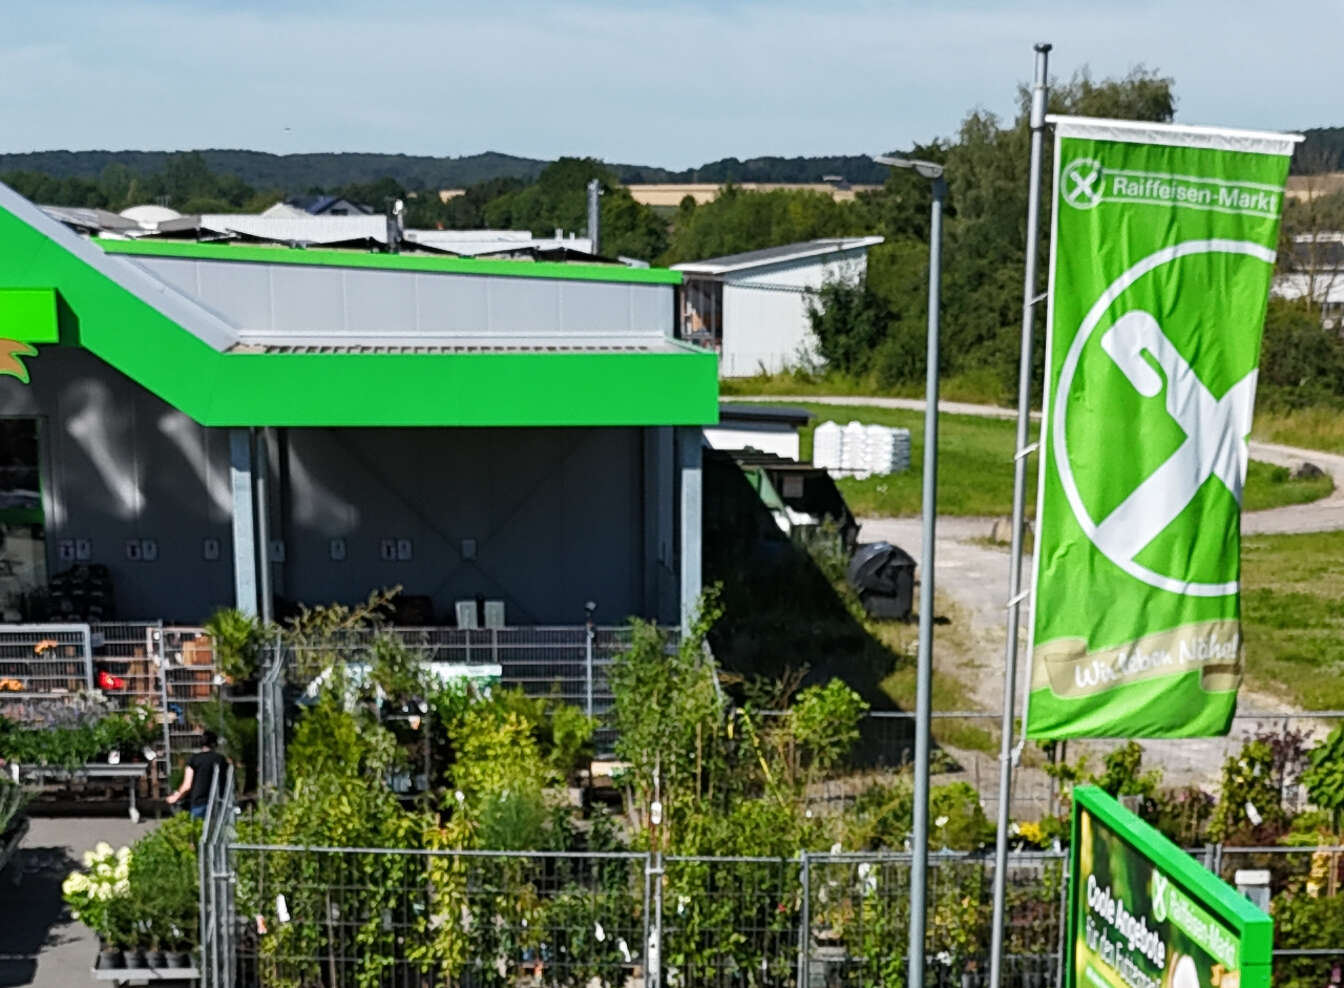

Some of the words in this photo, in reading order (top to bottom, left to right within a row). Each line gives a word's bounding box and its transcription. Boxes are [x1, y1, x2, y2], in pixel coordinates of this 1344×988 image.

[1112, 176, 1277, 213] Raiffeisen-Markt
[1075, 660, 1117, 688] Wir
[1087, 874, 1115, 925] Coole
[1115, 898, 1166, 969] Angebote
